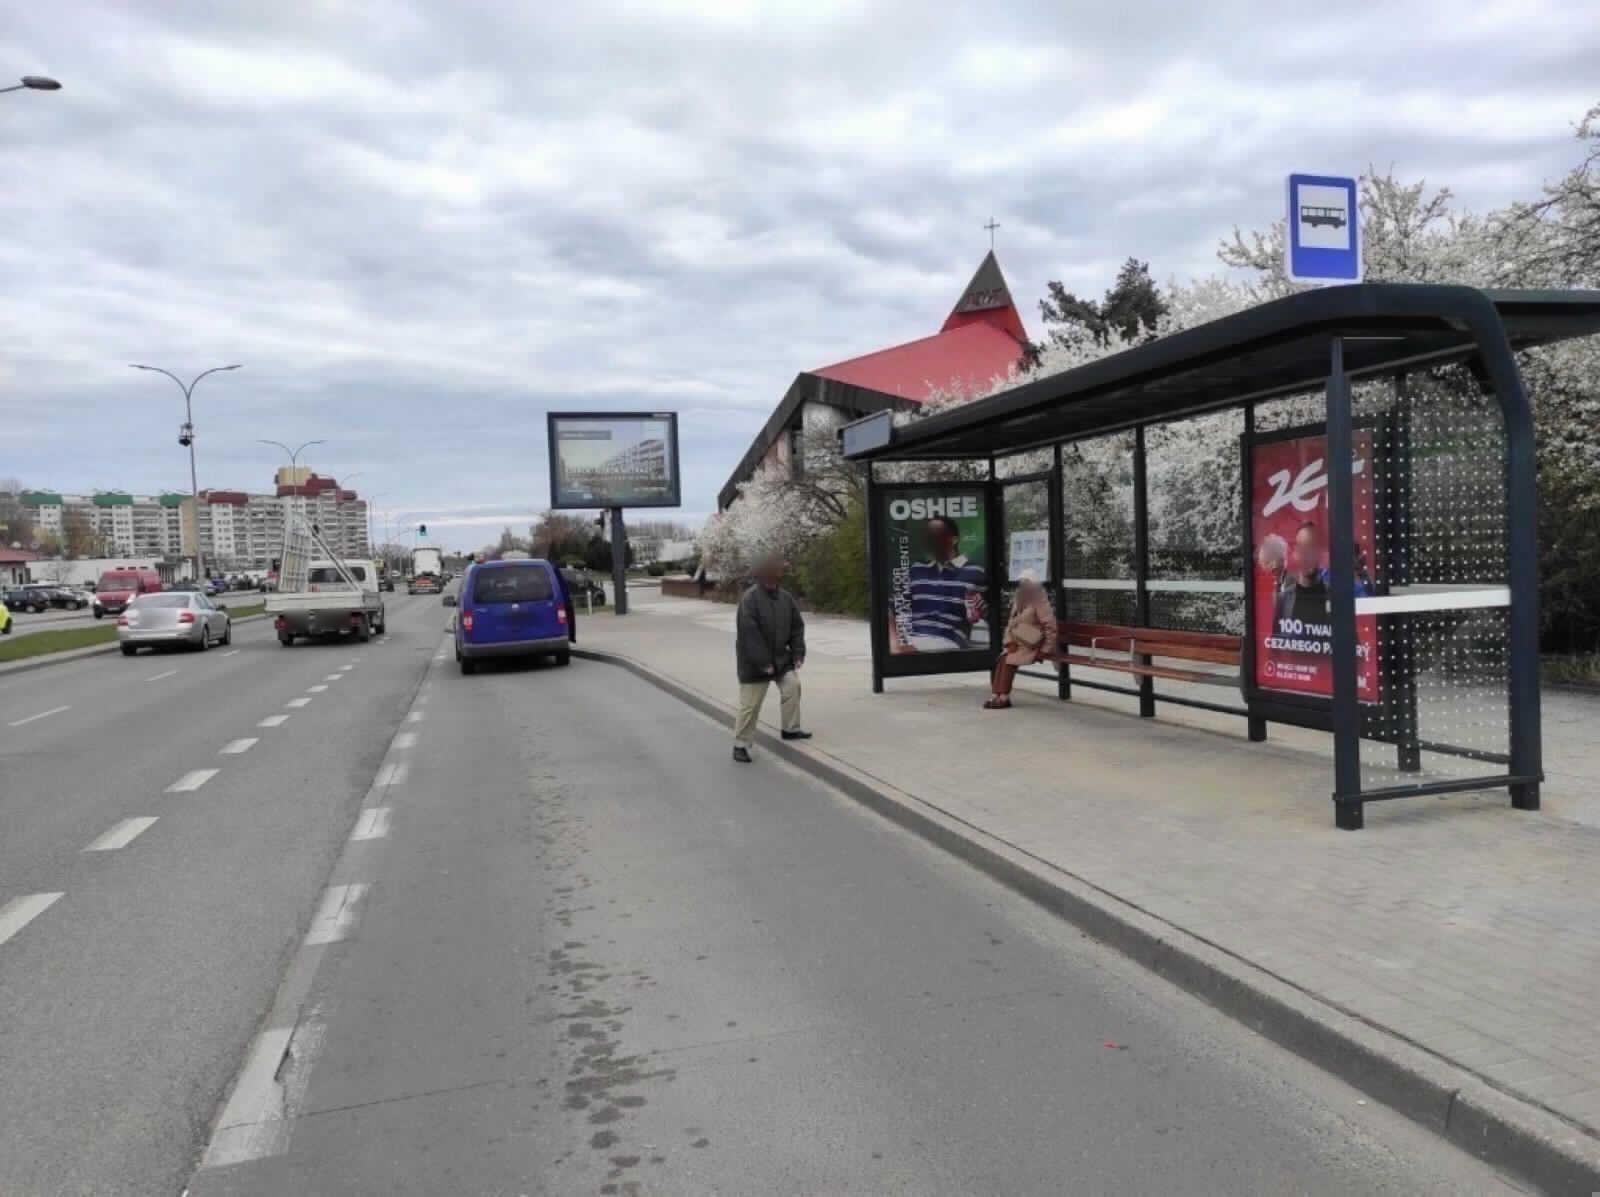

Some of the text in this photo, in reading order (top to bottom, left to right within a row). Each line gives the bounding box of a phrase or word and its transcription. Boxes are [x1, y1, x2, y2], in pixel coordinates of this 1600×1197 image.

[890, 496, 978, 520] OSHEE
[1278, 618, 1303, 634] 100
[1264, 637, 1321, 653] CEZAREGO
